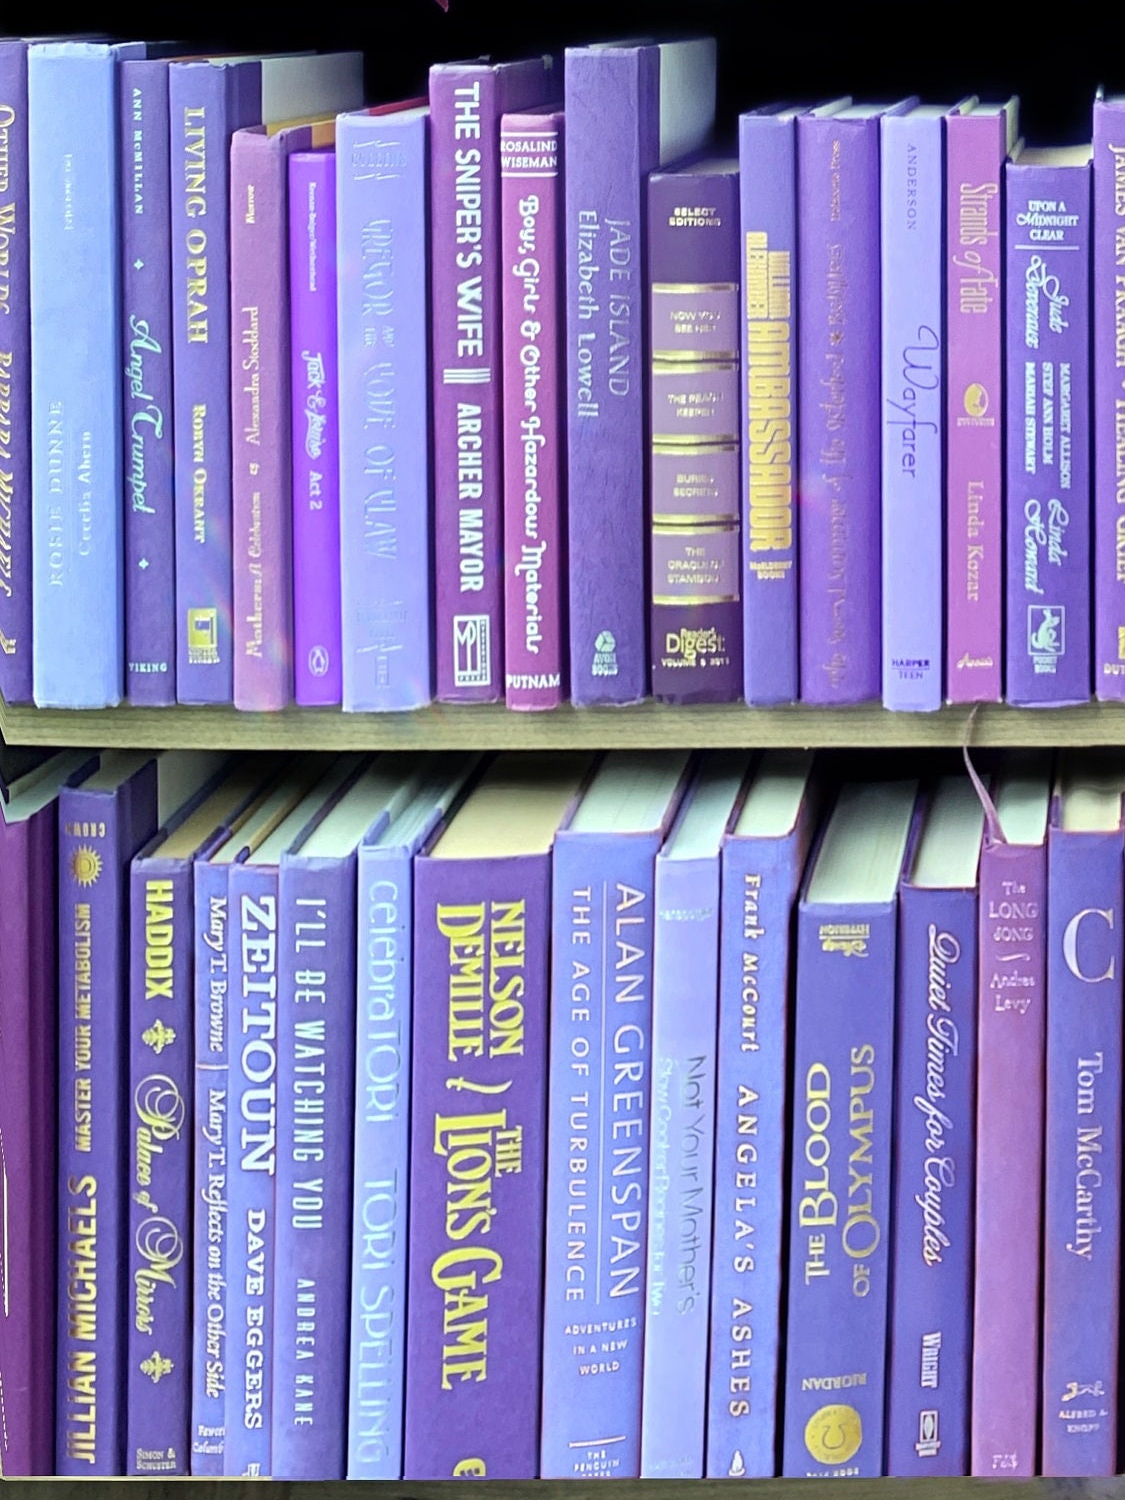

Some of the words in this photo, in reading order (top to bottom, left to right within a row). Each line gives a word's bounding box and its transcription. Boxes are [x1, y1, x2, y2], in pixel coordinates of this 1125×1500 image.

[132, 87, 143, 121] ANN
[454, 81, 481, 140] THE
[454, 148, 483, 269] SNIPER'S
[906, 143, 918, 230] ANDERSON
[577, 210, 601, 320] Elizabeth
[456, 275, 483, 358] WIFE
[577, 332, 599, 418] Lowell
[457, 402, 484, 500] ARCHER
[458, 510, 486, 593] MAYOR
[129, 661, 168, 673] VIKING
[505, 672, 561, 689] PUTNAM
[145, 879, 174, 1000] HADDIX
[572, 886, 591, 945] THE
[615, 883, 646, 1003] ALAN
[488, 898, 526, 1059] NELSON
[571, 960, 591, 1022] AGE
[241, 895, 278, 1177] ZEITOUN
[571, 1037, 590, 1077] OF
[1077, 1051, 1103, 1115] Tom
[609, 1023, 645, 1299] GREENSPAN
[732, 1083, 761, 1274] ANGELA'S
[798, 1062, 838, 1228] BLOOD
[841, 1043, 881, 1259] OLYMPUS
[564, 1091, 589, 1301] TURBULENCE
[1065, 1126, 1103, 1261] McCarthy
[245, 1209, 268, 1294] DAVE
[804, 1233, 831, 1285] THE
[852, 1263, 871, 1298] OF
[243, 1304, 265, 1430] EGGERS
[726, 1298, 755, 1419] ASHES
